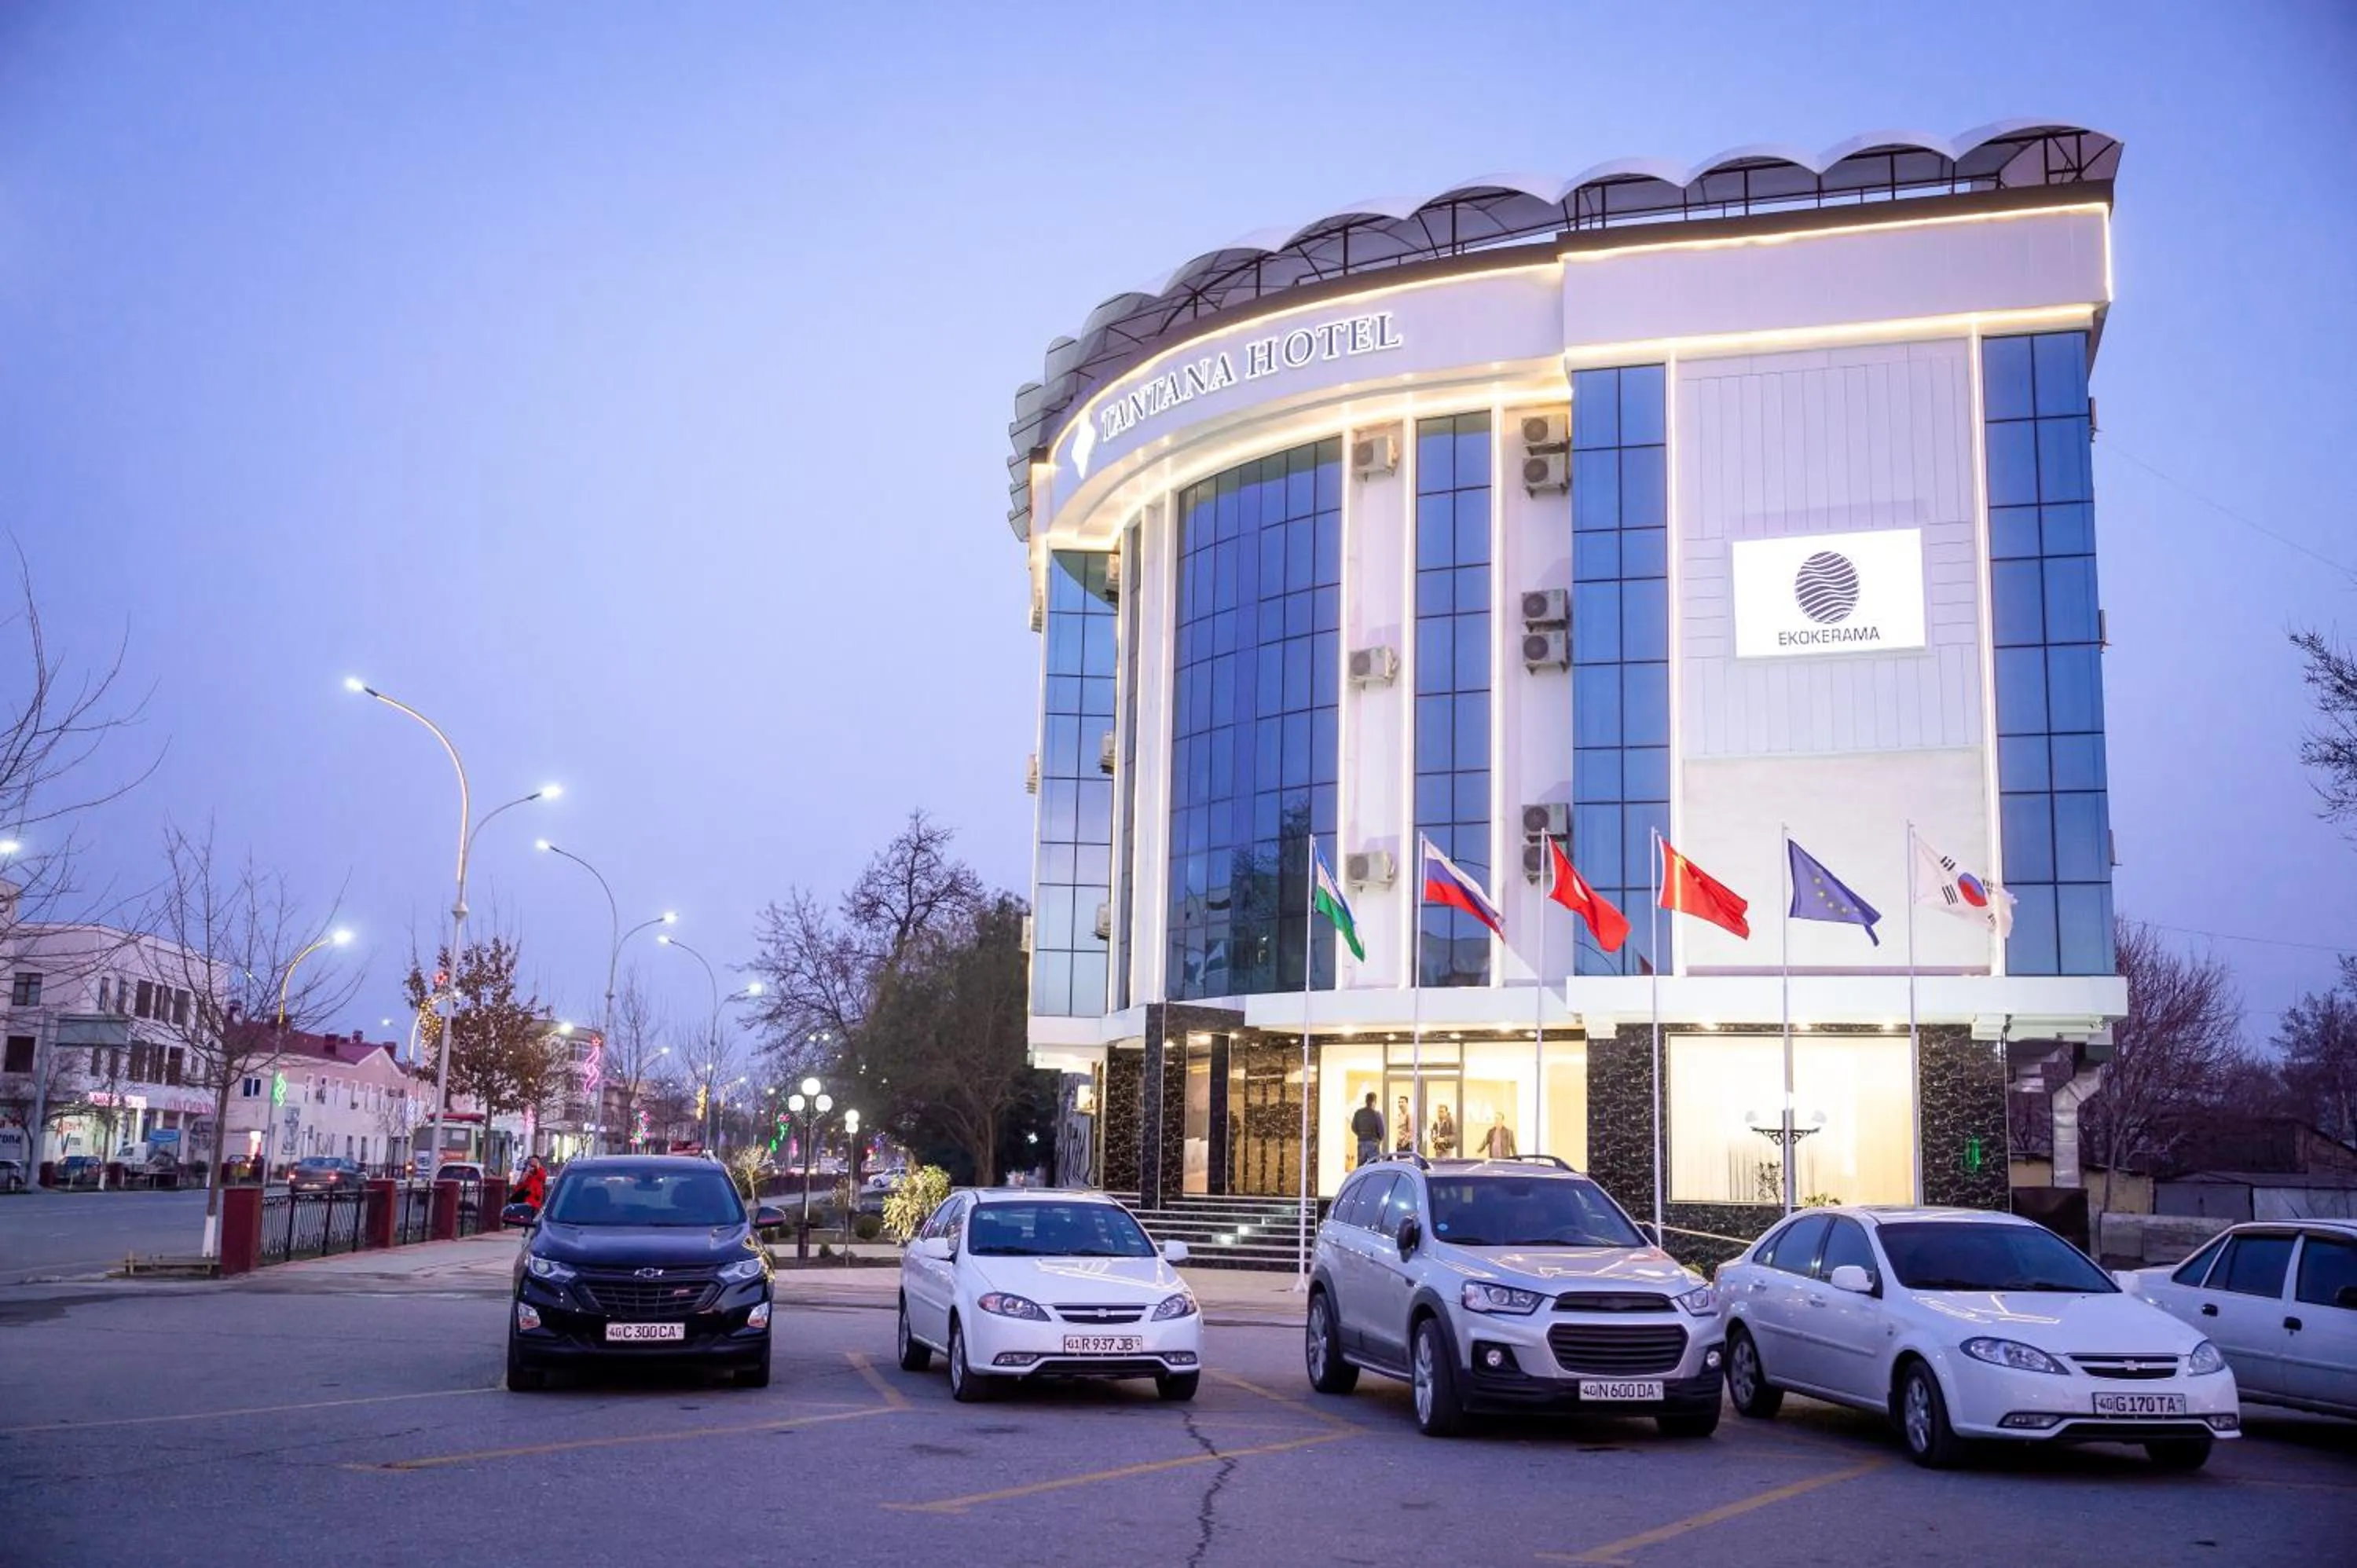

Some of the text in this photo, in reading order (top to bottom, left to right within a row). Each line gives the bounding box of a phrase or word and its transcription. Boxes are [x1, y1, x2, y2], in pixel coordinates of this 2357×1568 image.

[1101, 311, 1403, 442] TANTANA HOTEL
[1778, 626, 1880, 646] EKOKERAMA
